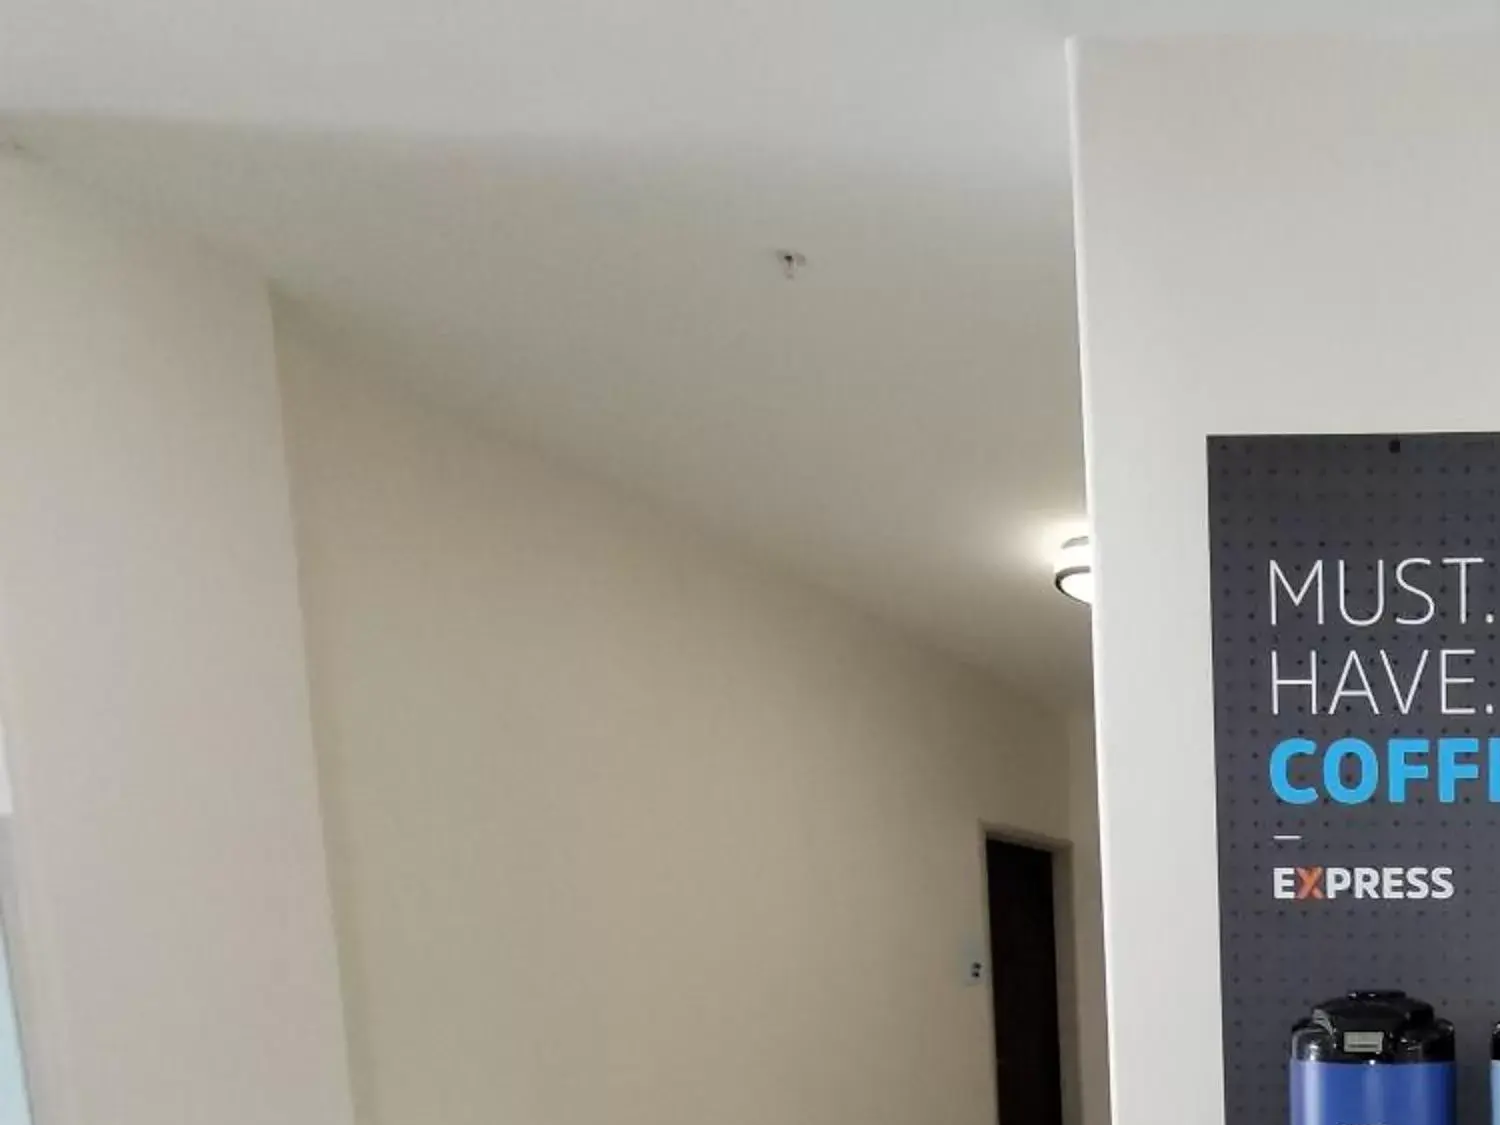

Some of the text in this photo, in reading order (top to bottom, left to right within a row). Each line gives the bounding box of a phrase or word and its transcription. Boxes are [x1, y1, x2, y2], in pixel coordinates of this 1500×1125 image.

[1269, 557, 1495, 626] MUST.
[1271, 648, 1495, 716] HAVE.
[1272, 866, 1455, 900] EXPRESS
